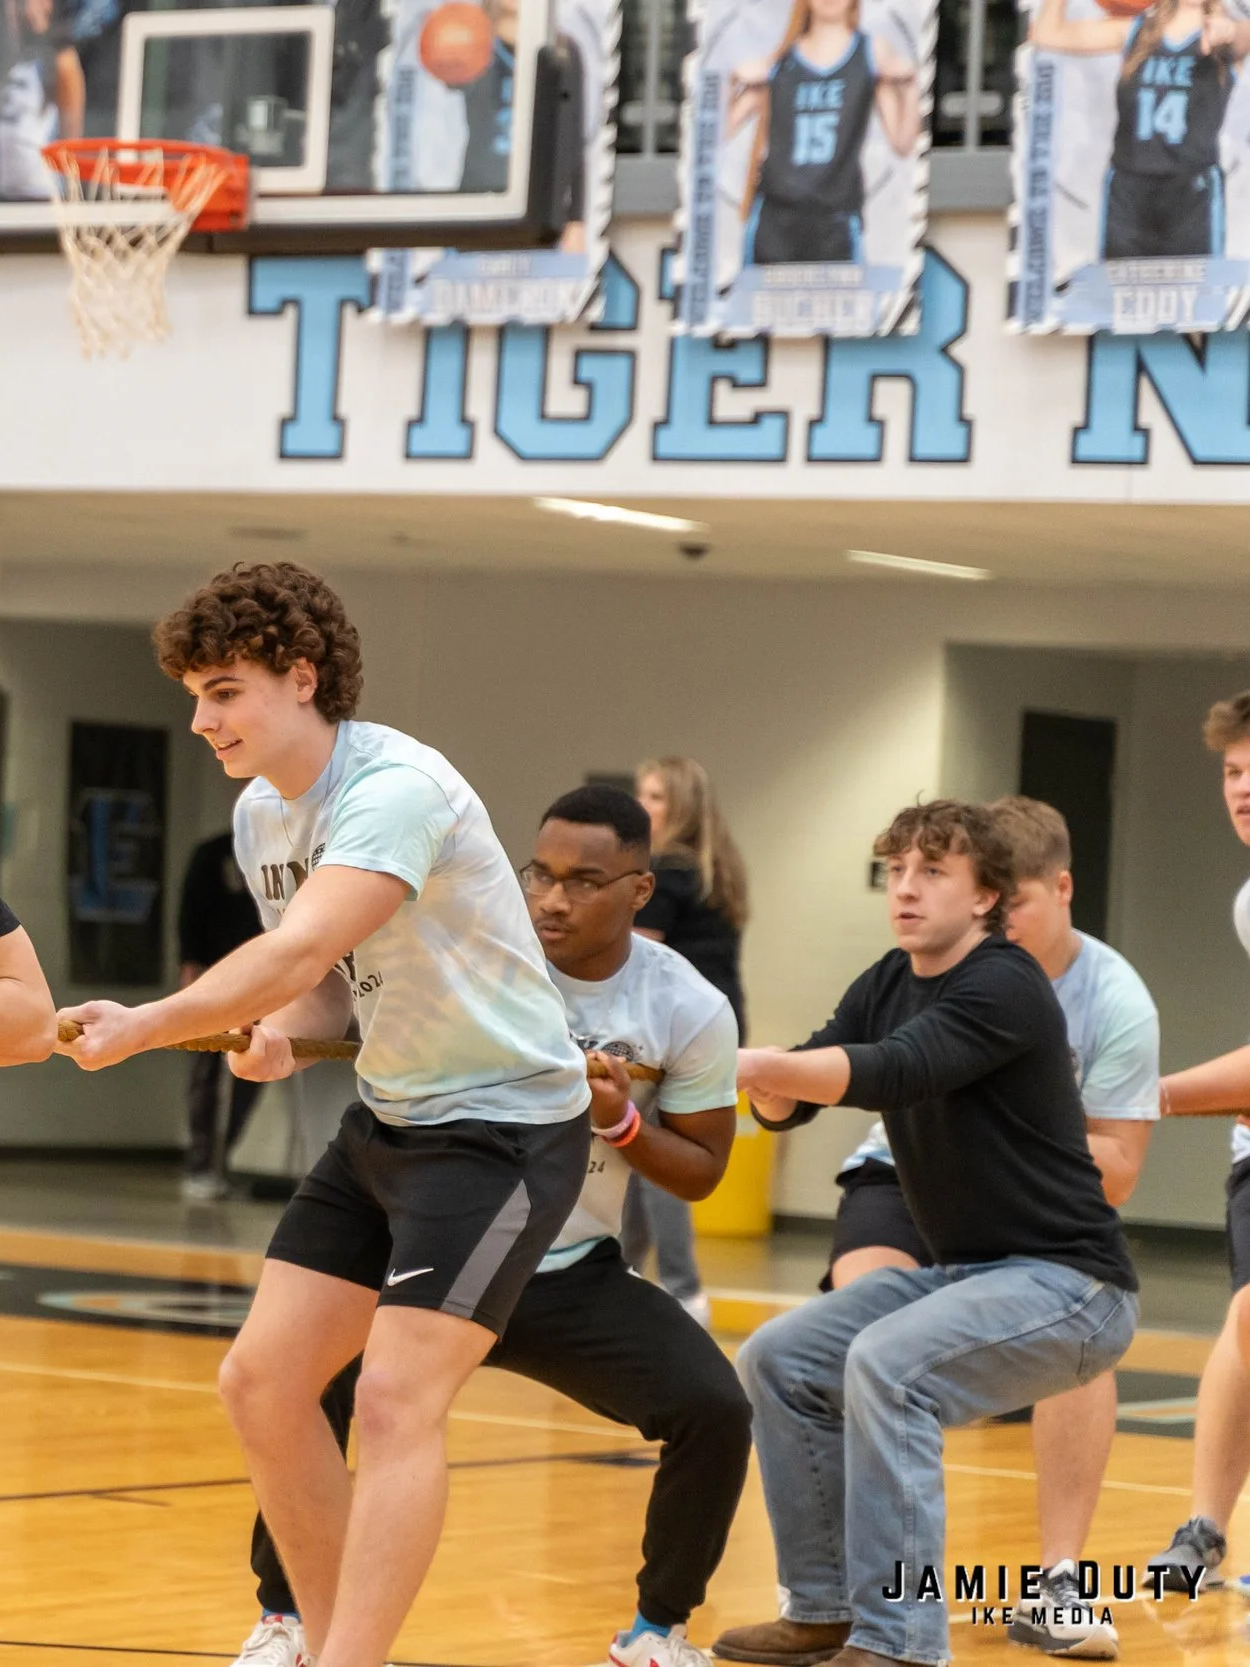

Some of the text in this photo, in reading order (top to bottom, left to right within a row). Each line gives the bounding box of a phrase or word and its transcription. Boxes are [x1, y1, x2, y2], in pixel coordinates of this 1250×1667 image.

[794, 79, 848, 110] IKE
[1141, 55, 1198, 88] IKE
[792, 111, 841, 168] 15
[1135, 86, 1190, 145] 14
[1112, 286, 1198, 328] EDDY
[248, 247, 973, 461] TIGER
